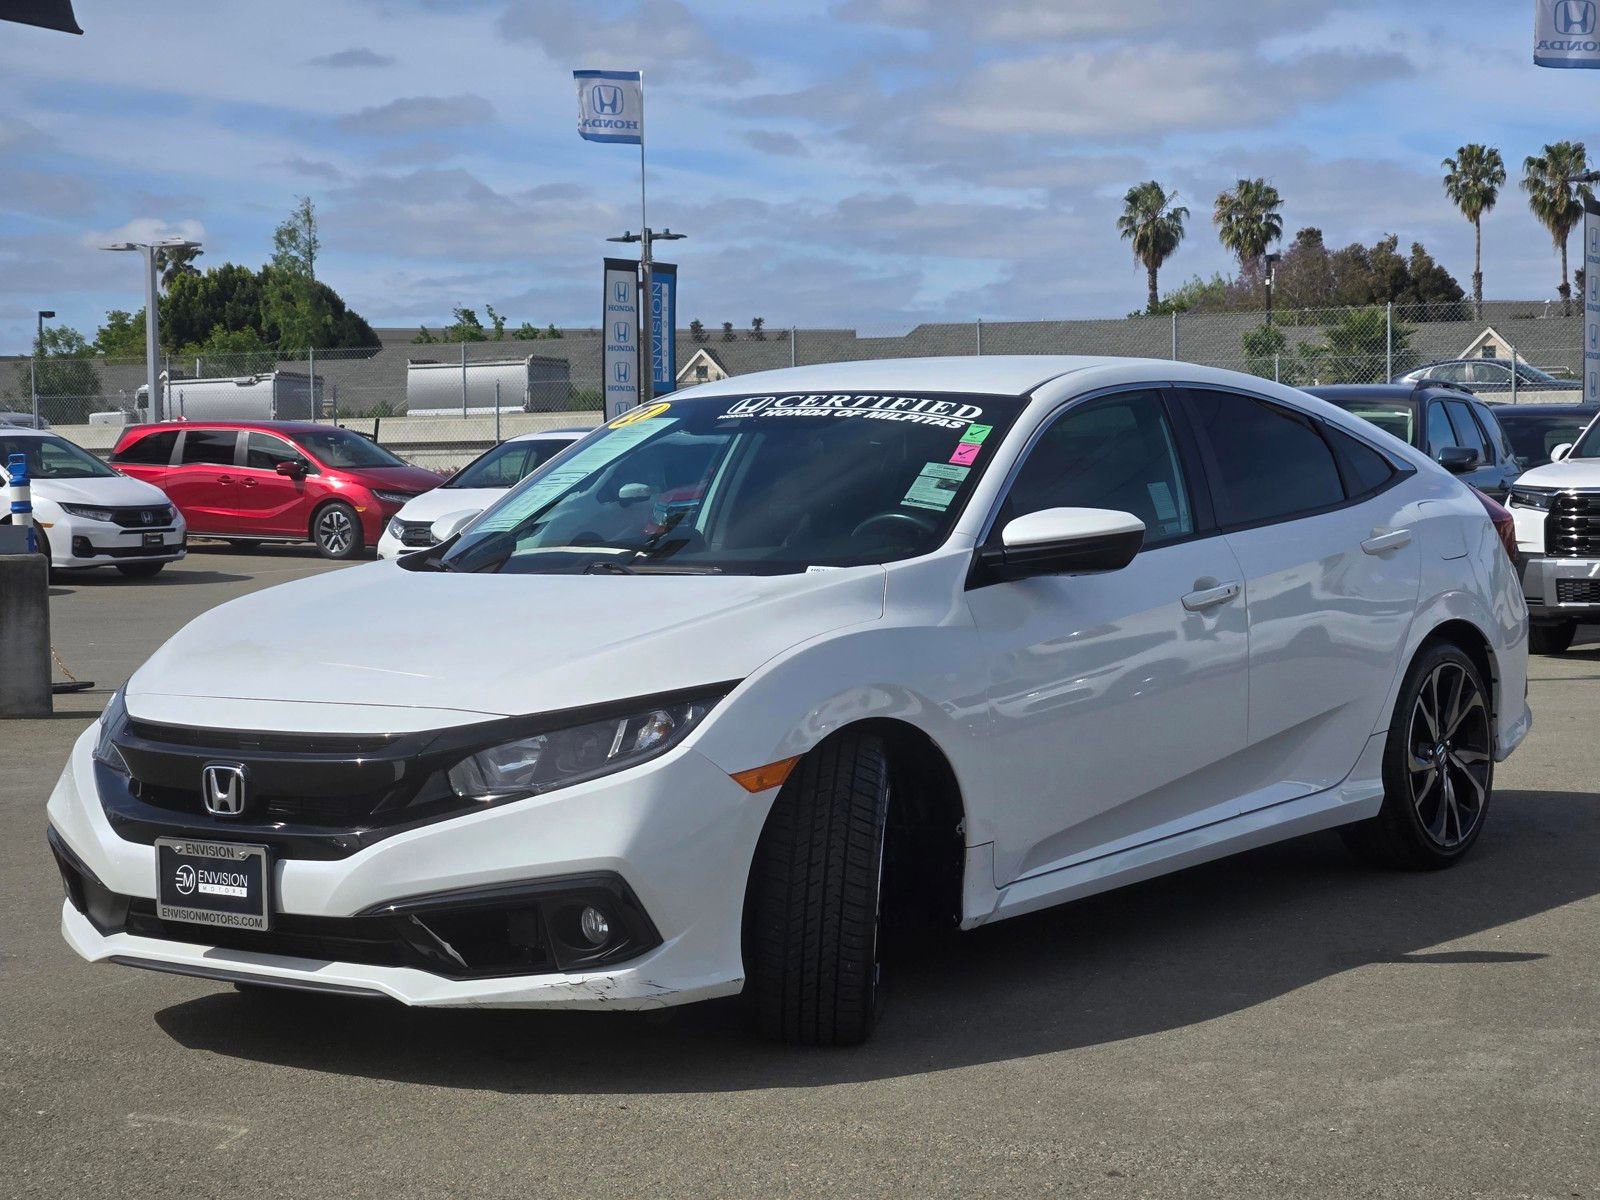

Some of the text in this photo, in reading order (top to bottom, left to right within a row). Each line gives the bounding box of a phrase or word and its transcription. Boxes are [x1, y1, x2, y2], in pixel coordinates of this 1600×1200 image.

[608, 304, 635, 313] HONDA
[652, 282, 662, 382] ENVISION
[607, 344, 636, 353] HONDA
[608, 384, 636, 393] HONDA
[774, 394, 983, 419] CERTIFIED
[760, 409, 966, 429] HONDA OF MILPITAS
[185, 843, 235, 858] ENVISION
[198, 870, 248, 887] ENVISION
[161, 907, 263, 928] ENVISIONMOTORS.COM
